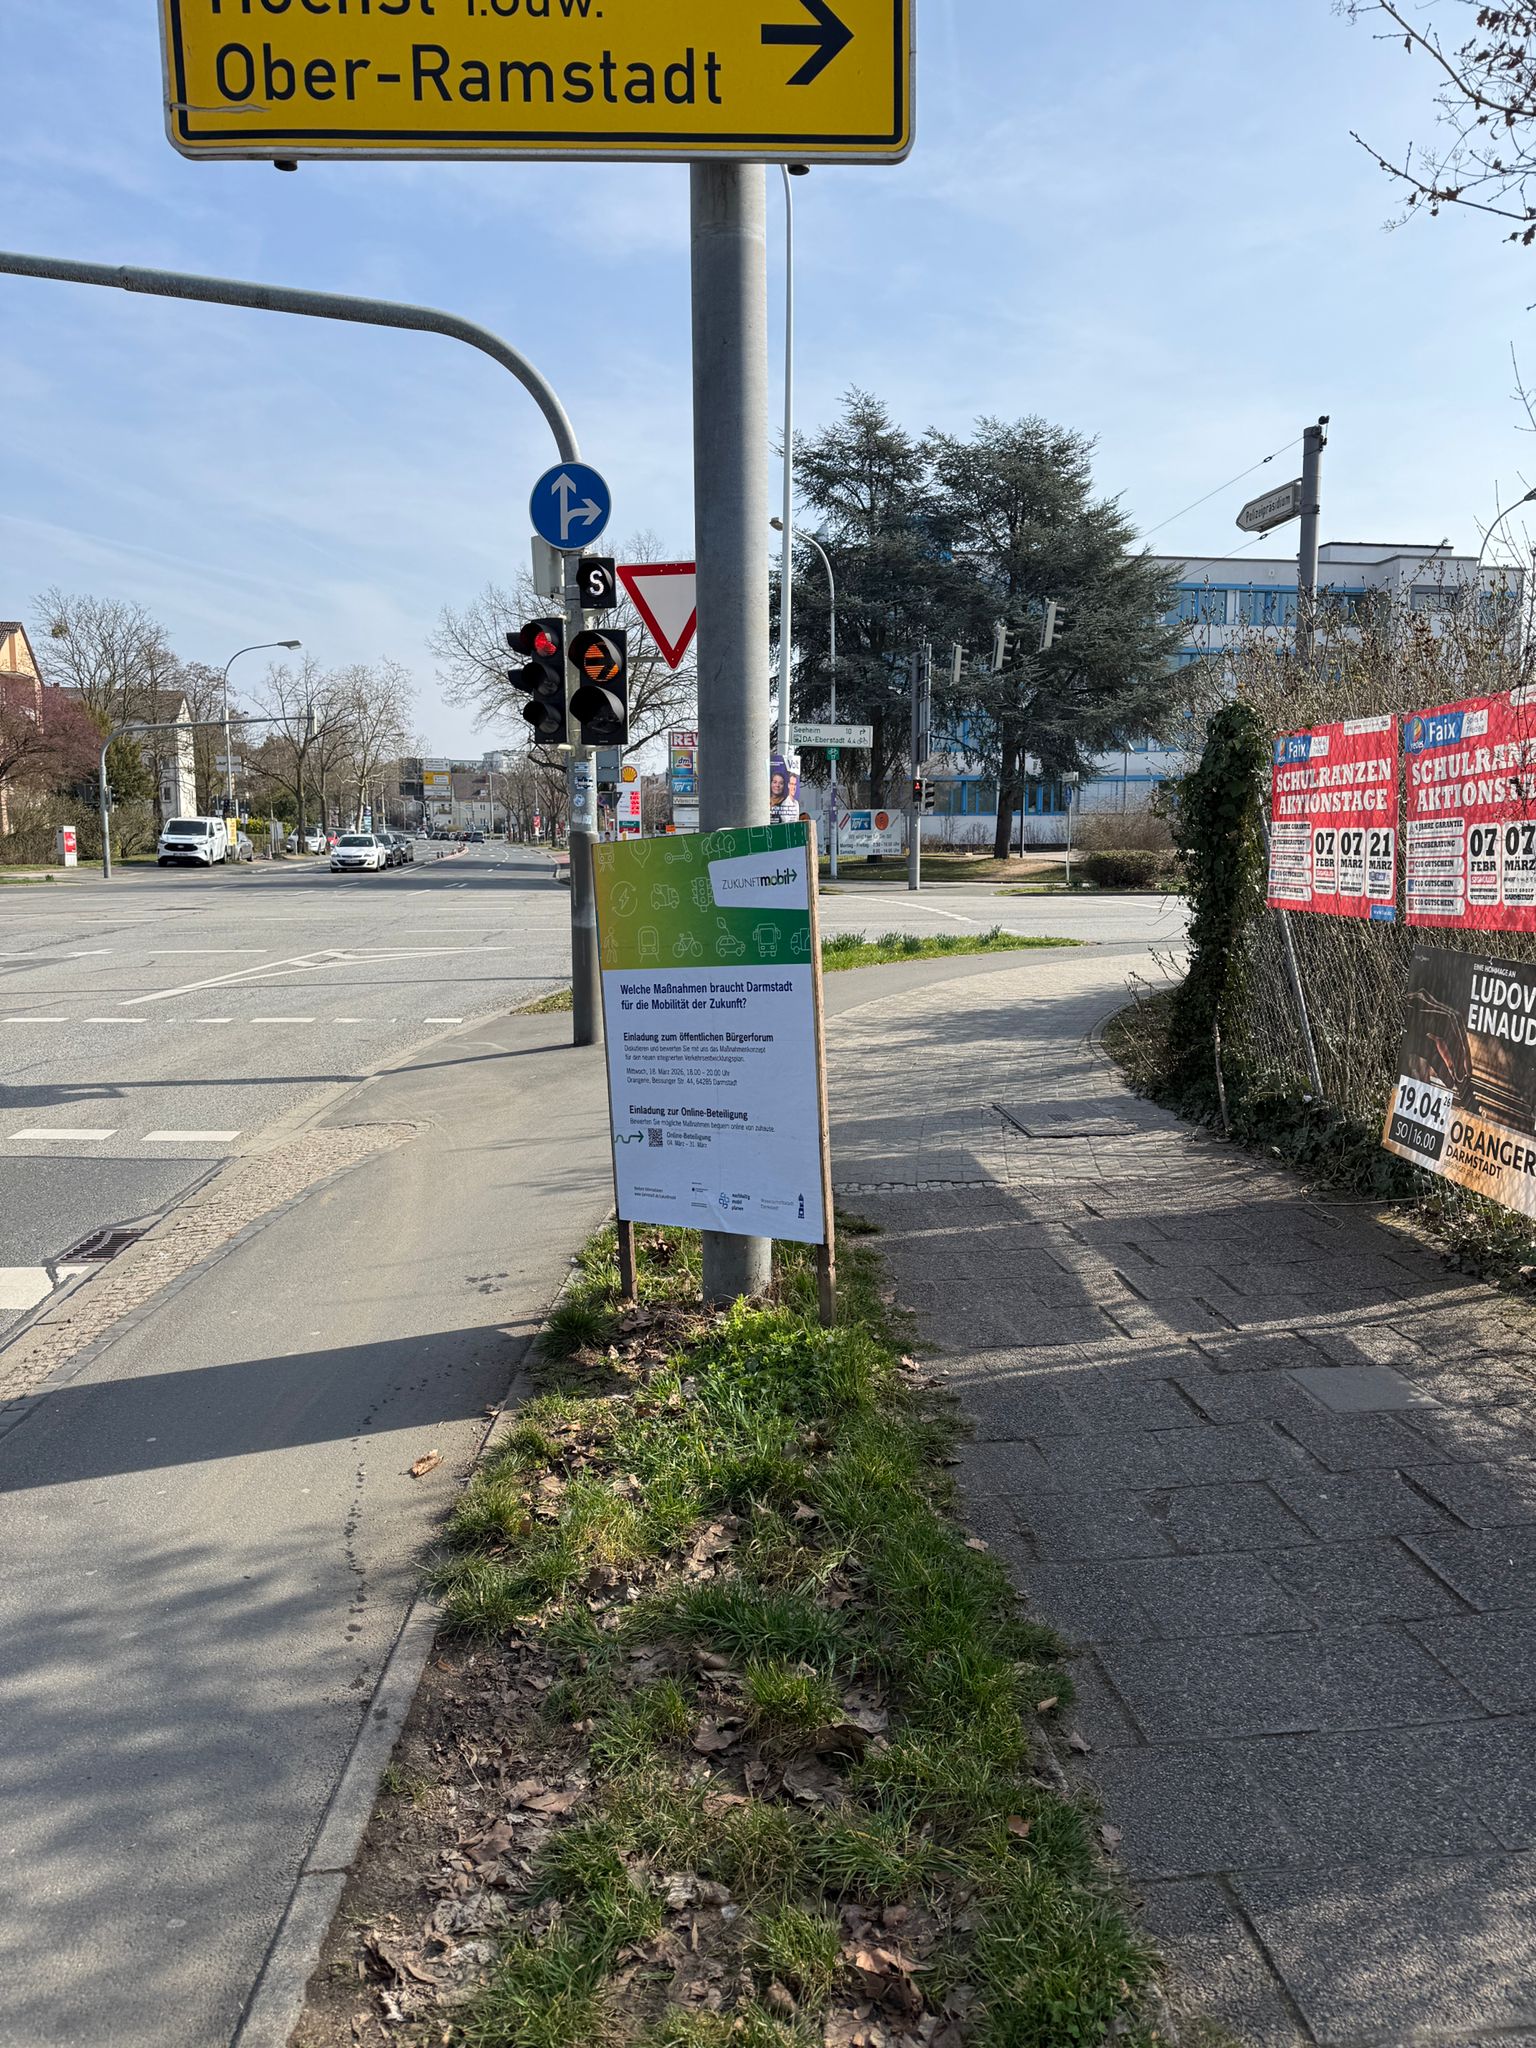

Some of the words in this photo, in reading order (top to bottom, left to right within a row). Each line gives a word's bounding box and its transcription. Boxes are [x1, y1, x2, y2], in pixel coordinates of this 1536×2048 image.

[215, 43, 723, 105] Ober-Ramstadt
[1245, 494, 1291, 524] Polizeipräsidium
[589, 569, 605, 596] S
[793, 726, 821, 734] Seeheim
[1429, 718, 1456, 742] Faix
[1288, 739, 1307, 758] Faix
[1276, 758, 1392, 793] SCHULRANZEN
[1279, 788, 1388, 814] AKTIONSTAGE
[1419, 822, 1434, 832] JAHRE
[1435, 820, 1463, 829] GARANTIE
[1315, 832, 1335, 855] 07
[1340, 832, 1363, 856] 07
[1370, 832, 1391, 857] 21
[1470, 829, 1497, 857] 07
[1505, 826, 1536, 856] 07
[1316, 858, 1334, 867] FEBR
[1340, 856, 1363, 868] MÄRZ
[1369, 857, 1392, 870] MÄRZ
[1424, 860, 1454, 868] GUTSCHEIN
[1471, 861, 1496, 871] FEBR
[1505, 856, 1536, 871] MÄRZ
[1473, 963, 1484, 972] EINE
[1484, 965, 1509, 977] HOMMAGE
[1508, 970, 1516, 978] AN
[620, 984, 650, 995] Welche
[653, 983, 707, 994] Maßnahmen
[710, 982, 744, 993] braucht
[746, 980, 793, 992] Darmstadt
[1470, 974, 1536, 1013] LUDOV
[621, 1000, 633, 1010] für
[636, 1000, 648, 1010] die
[652, 998, 690, 1010] Mobilität
[692, 998, 706, 1009] der
[710, 998, 747, 1008] Zukunft?
[1467, 1004, 1536, 1046] EINAUD
[623, 1032, 659, 1044] Einladung
[661, 1034, 678, 1042] zum
[679, 1032, 724, 1042] öffentlichen
[726, 1032, 774, 1044] Bürgerforum
[650, 1044, 659, 1052] und
[659, 1044, 682, 1052] bewerten
[682, 1044, 691, 1052] Sie
[691, 1044, 699, 1052] mit
[658, 1068, 670, 1076] März
[629, 1105, 665, 1117] Einladung
[667, 1108, 679, 1116] zur
[681, 1106, 748, 1121] Online-Beteiligung
[1400, 1084, 1444, 1126] 19.04.
[1443, 1096, 1451, 1108] 26
[661, 1119, 682, 1127] mögliche
[666, 1132, 712, 1142] Online-Beteiligung
[1450, 1120, 1536, 1178] ORANGER
[1446, 1144, 1502, 1179] DARMSTADT
